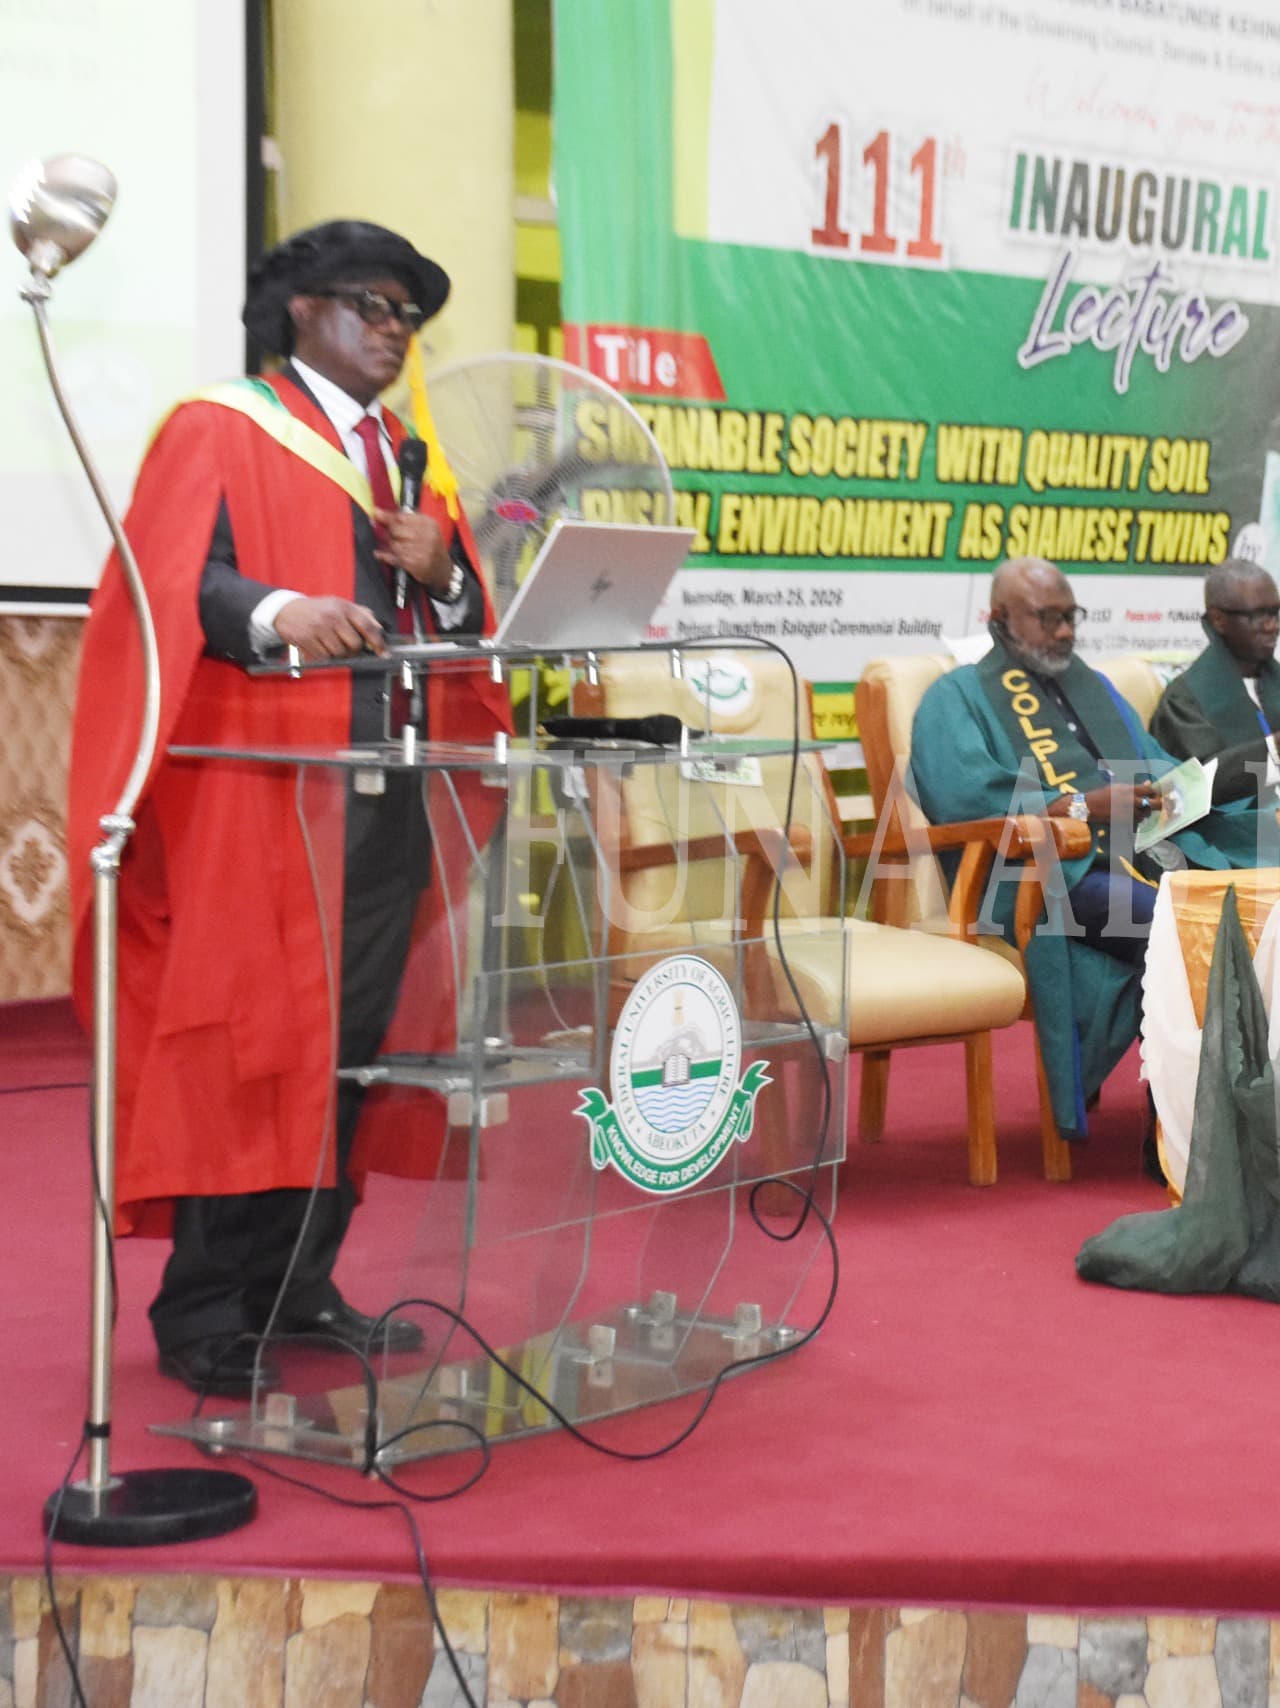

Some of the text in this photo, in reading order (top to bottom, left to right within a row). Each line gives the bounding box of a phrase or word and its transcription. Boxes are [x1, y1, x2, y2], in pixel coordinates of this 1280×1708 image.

[1009, 152, 1270, 261] INAUGURAL
[1018, 248, 1246, 393] Lecture
[788, 413, 928, 480] SOCIETY
[936, 423, 1023, 486] WITH
[1025, 428, 1149, 493] QUALITY
[1148, 436, 1211, 495] SOIL
[717, 492, 953, 559] ENVIRONMENT
[957, 503, 1004, 560] AS
[1005, 504, 1134, 562] SIAMESE
[1133, 510, 1231, 566] TWINS
[742, 587, 783, 607] March
[897, 617, 943, 641] Building
[606, 1102, 743, 1185] KNOWLEDGE FOR DEVELOPMENT
